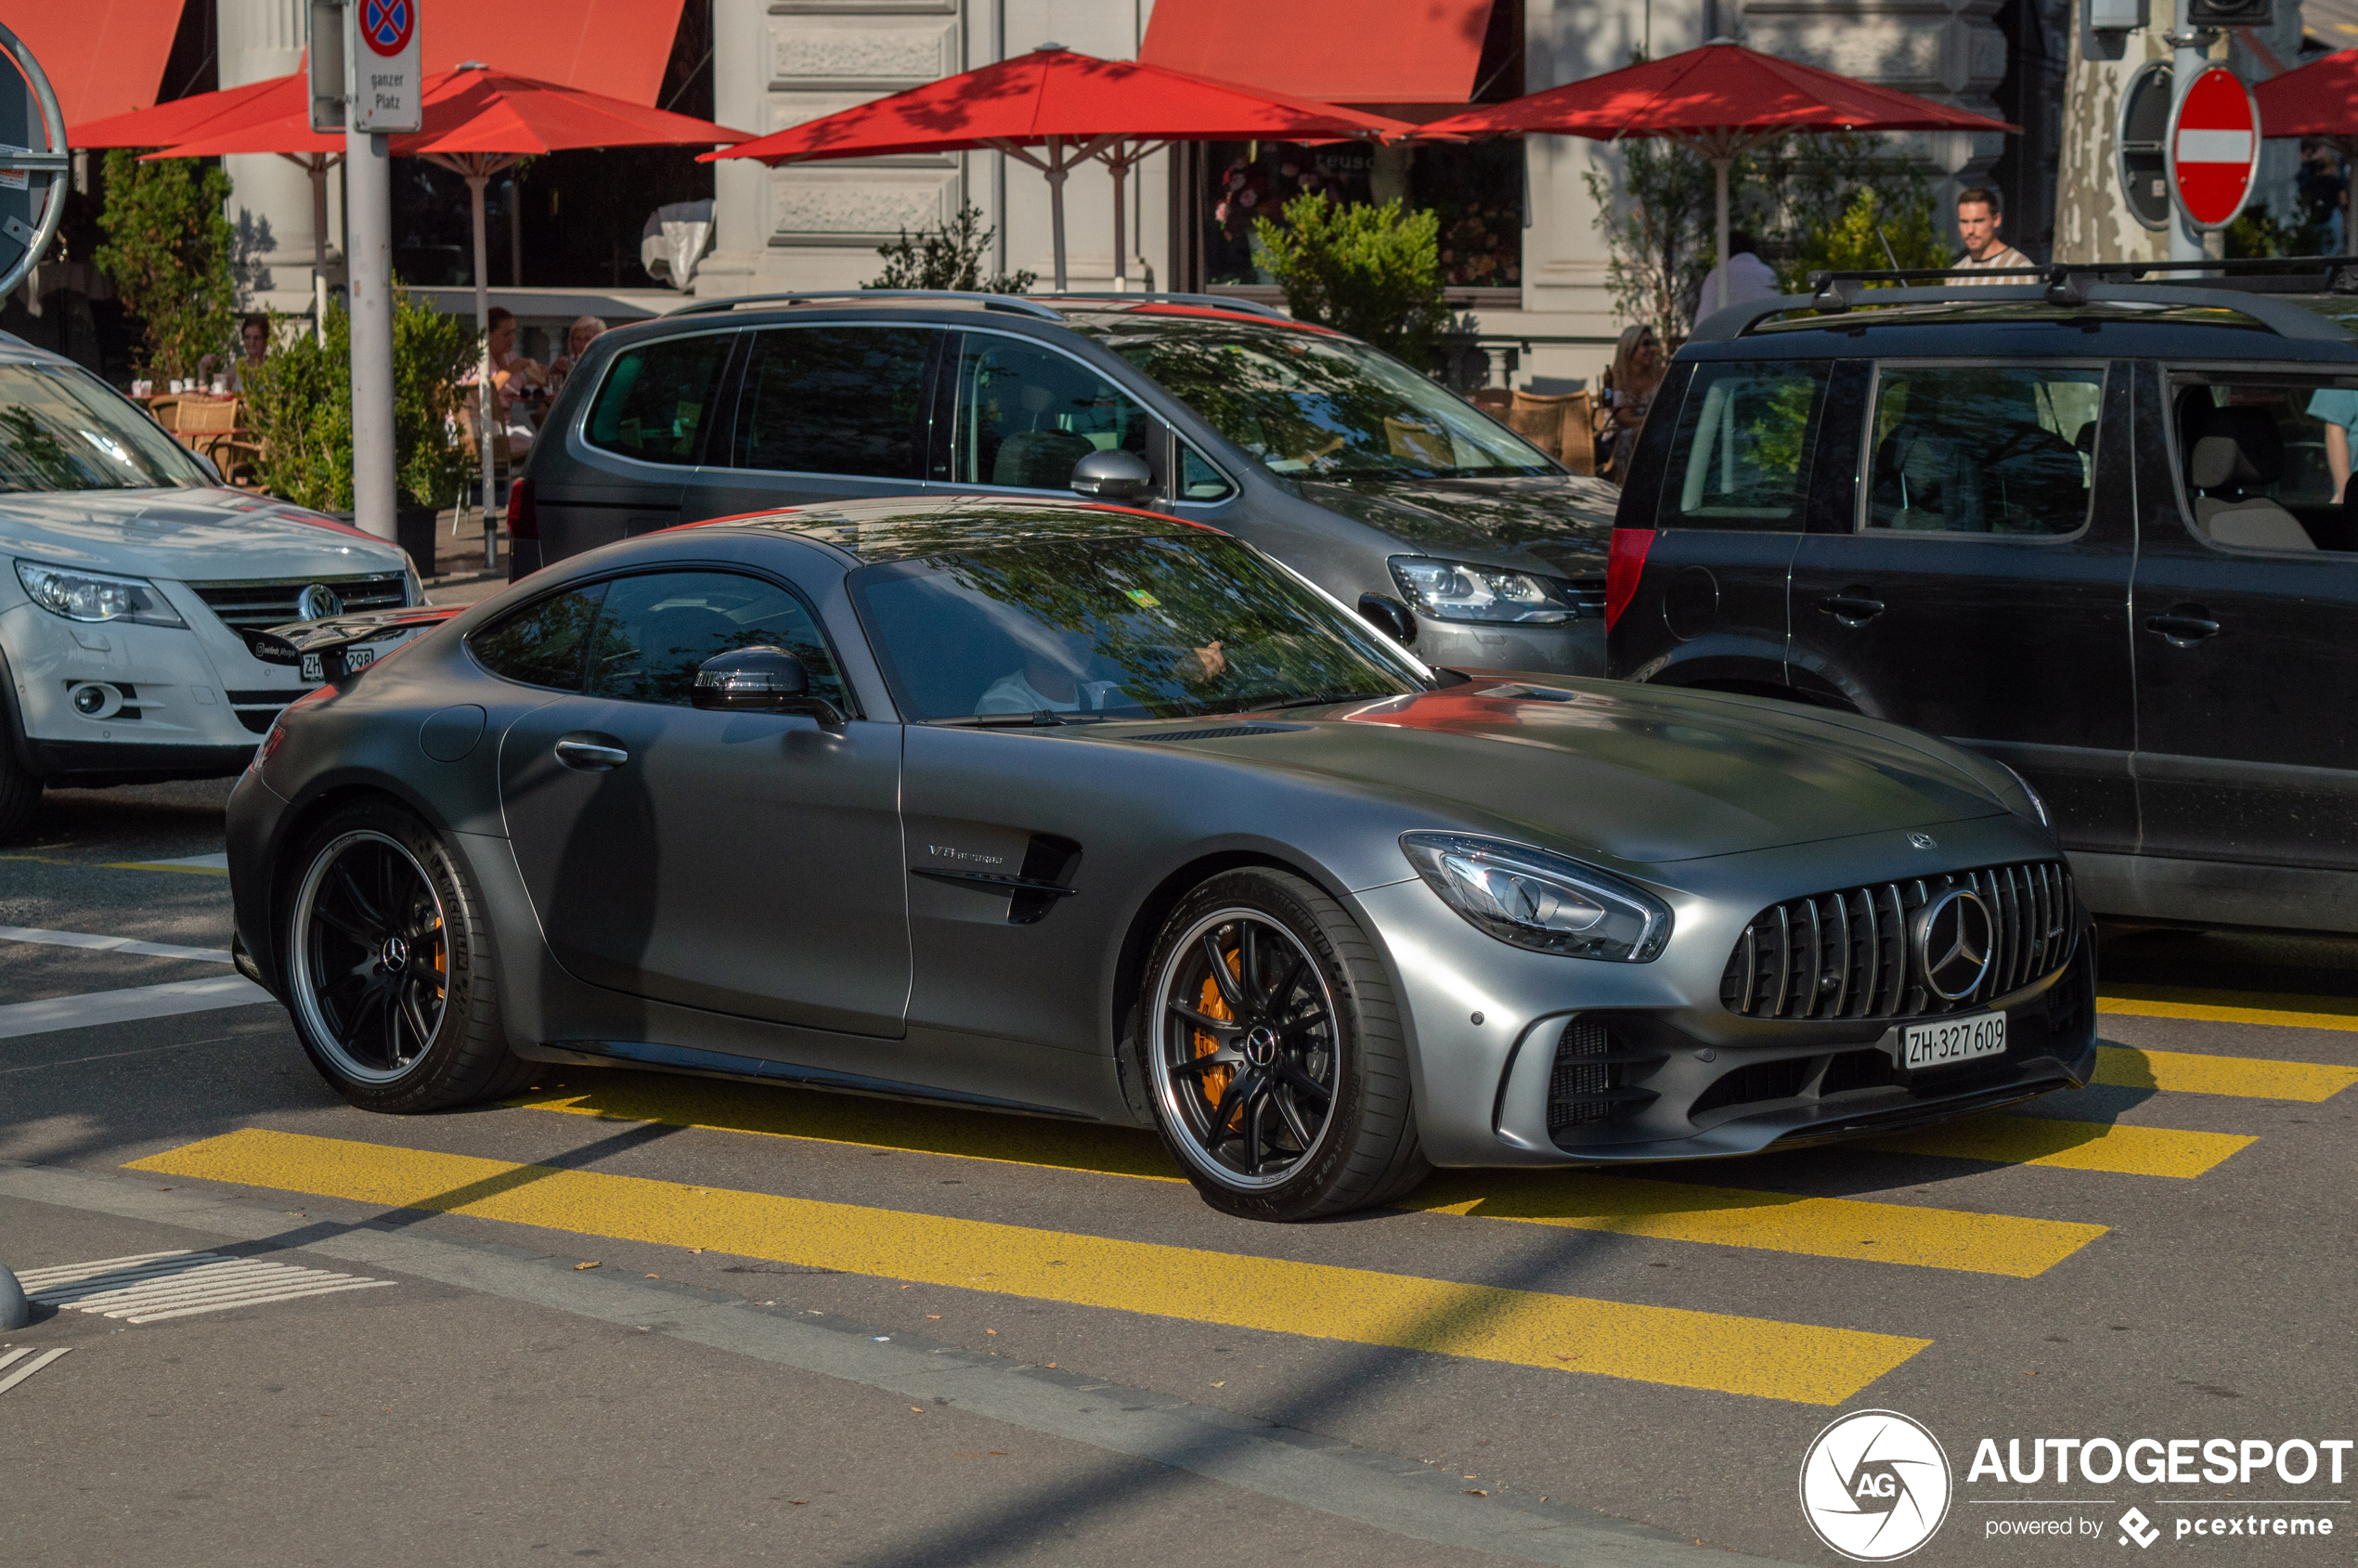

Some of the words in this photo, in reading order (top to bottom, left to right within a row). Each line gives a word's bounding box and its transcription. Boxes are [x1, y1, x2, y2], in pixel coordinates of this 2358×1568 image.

[372, 74, 404, 90] ganzer
[376, 93, 400, 110] Platz
[928, 845, 955, 858] V8
[440, 877, 468, 970] MICHELIN
[1272, 888, 1334, 961] MICHELIN
[1322, 1153, 1337, 1173] Cup
[1315, 1173, 1323, 1186] 2
